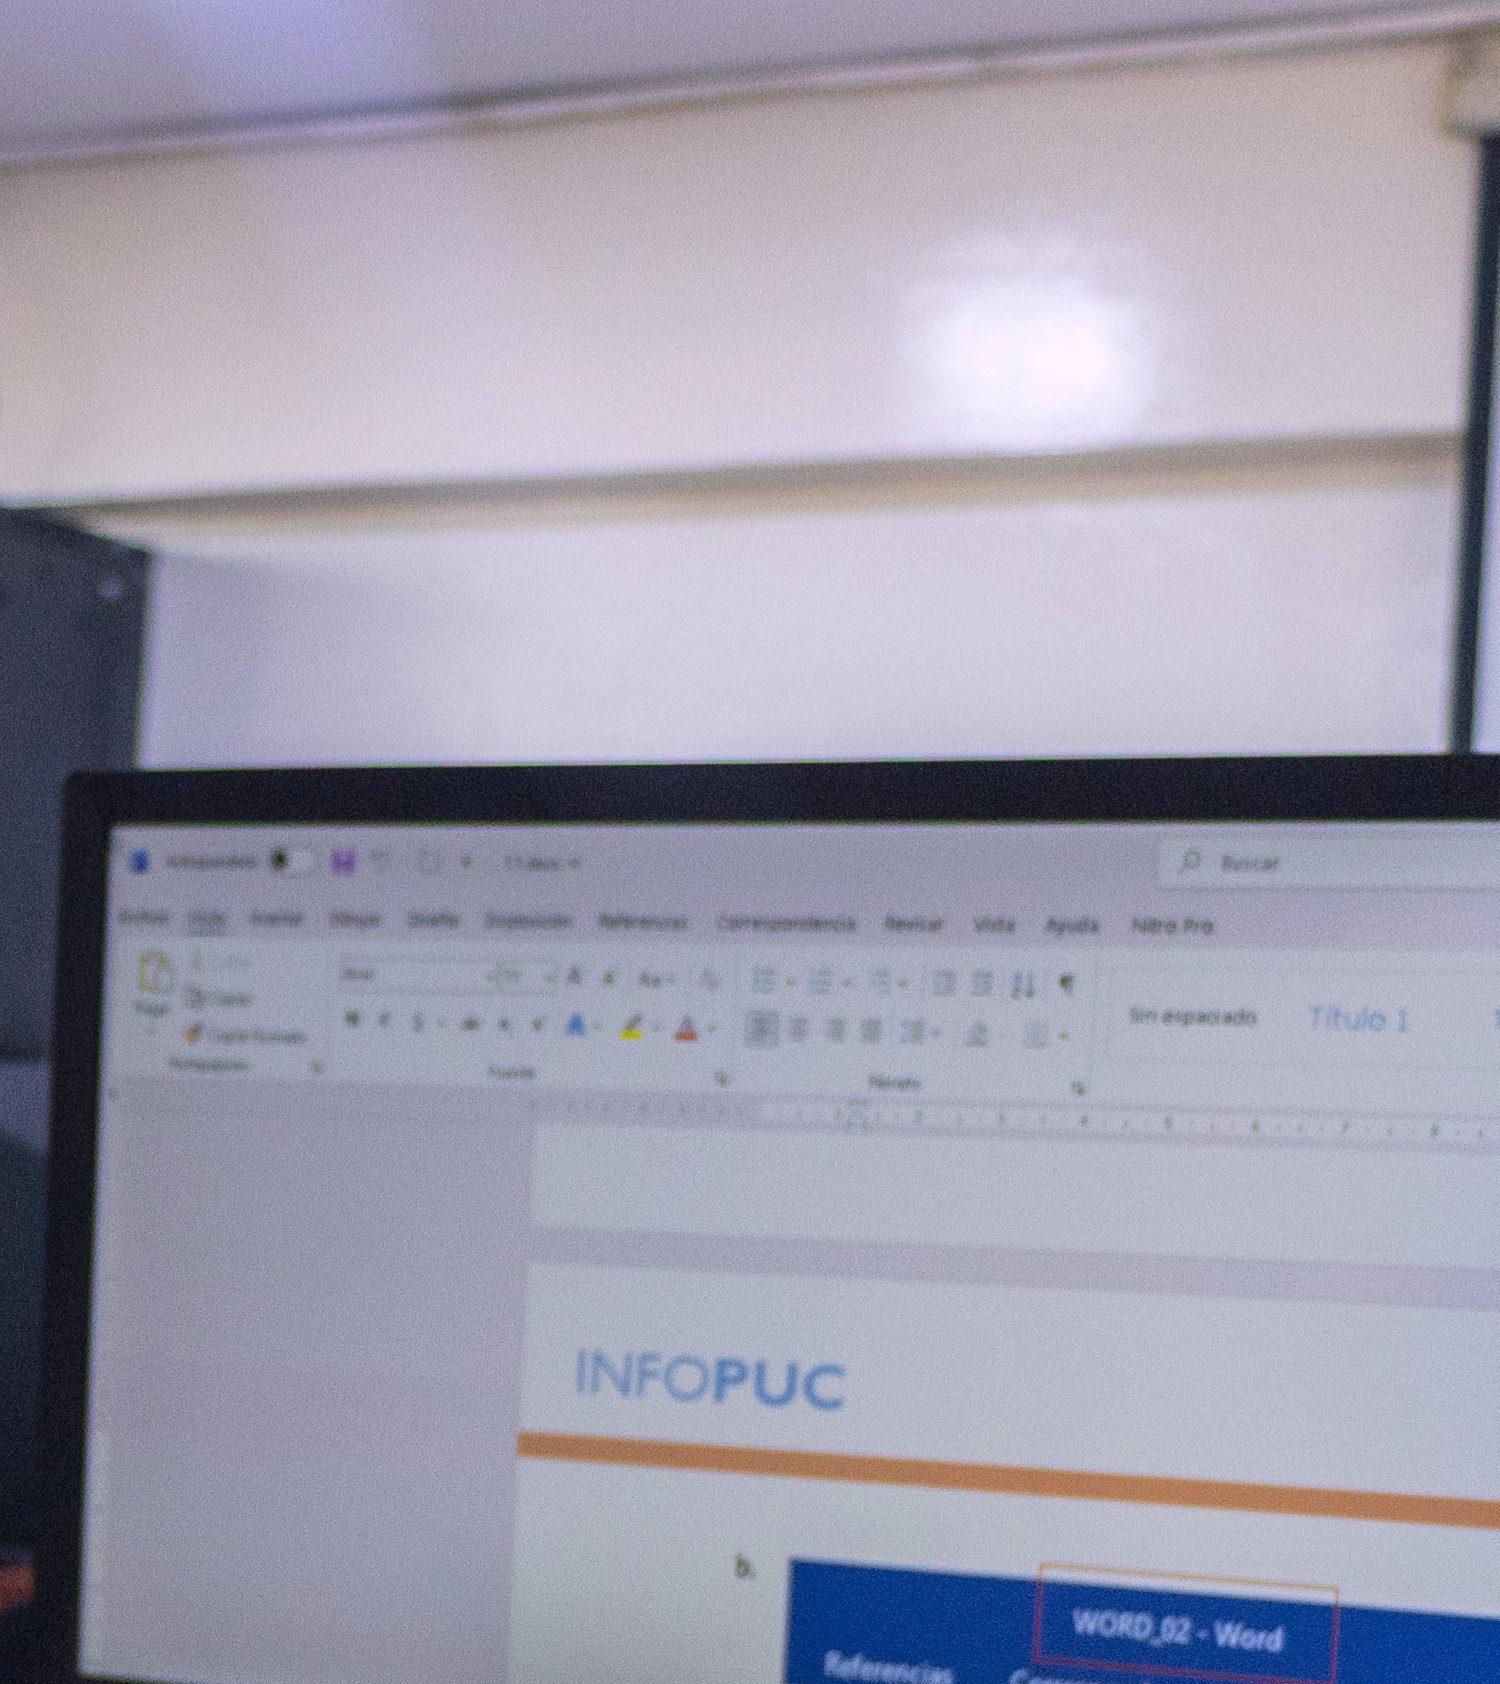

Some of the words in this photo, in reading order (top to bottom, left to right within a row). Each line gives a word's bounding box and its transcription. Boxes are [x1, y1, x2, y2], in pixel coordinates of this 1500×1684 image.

[1220, 851, 1281, 873] Buscar
[1309, 1003, 1388, 1034] Título
[574, 1348, 847, 1412] INFOPUC
[1072, 1606, 1193, 1648] WORD_02
[1213, 1617, 1286, 1655] Word
